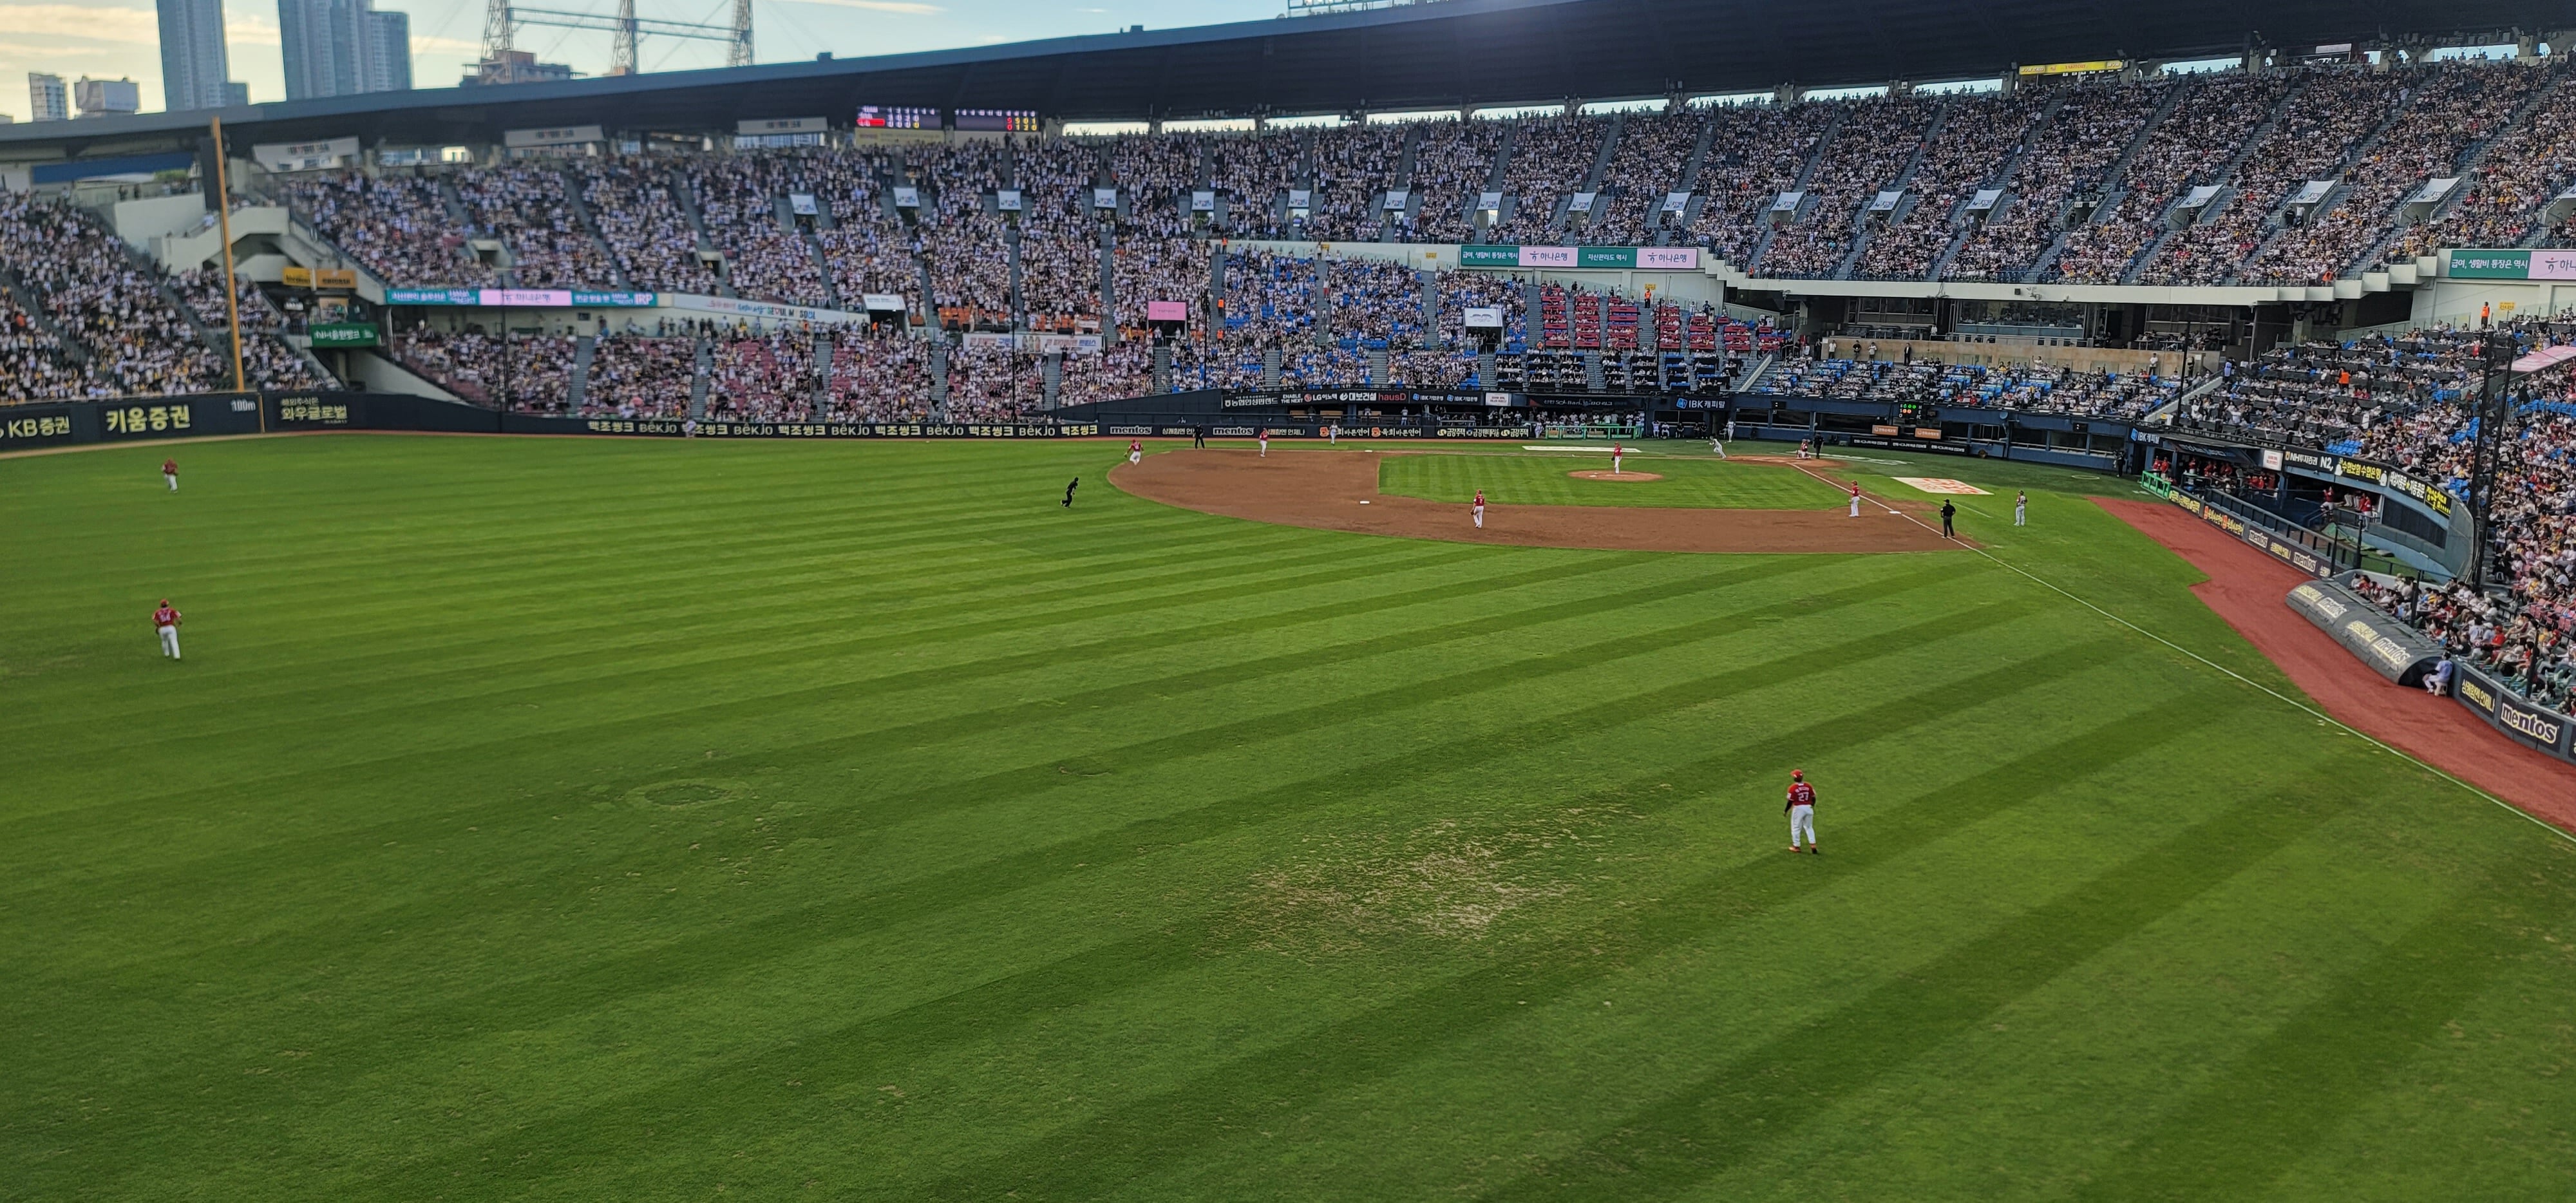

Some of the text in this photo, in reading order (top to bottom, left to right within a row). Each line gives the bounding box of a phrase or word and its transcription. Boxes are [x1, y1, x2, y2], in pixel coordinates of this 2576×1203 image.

[2468, 259, 2490, 269] 생활비
[2490, 259, 2512, 269] 통장은
[2514, 260, 2528, 269] 역시
[231, 398, 256, 412] 100m
[106, 404, 191, 433] 키움증권
[280, 404, 348, 421] 와우글로벌
[778, 424, 826, 436] 백조씽크
[875, 425, 922, 436] 백조씽크
[969, 425, 1014, 437] 백조씽크
[1061, 424, 1098, 436] 백조씽크
[1110, 425, 1152, 435] mentos
[1213, 425, 1255, 435] mentos
[2248, 529, 2269, 548] mentos
[2293, 551, 2318, 573] mentos
[2372, 636, 2411, 665] mentos
[2479, 690, 2496, 713] 언제나
[2501, 702, 2558, 744] mentos
[1798, 791, 1810, 802] 27
